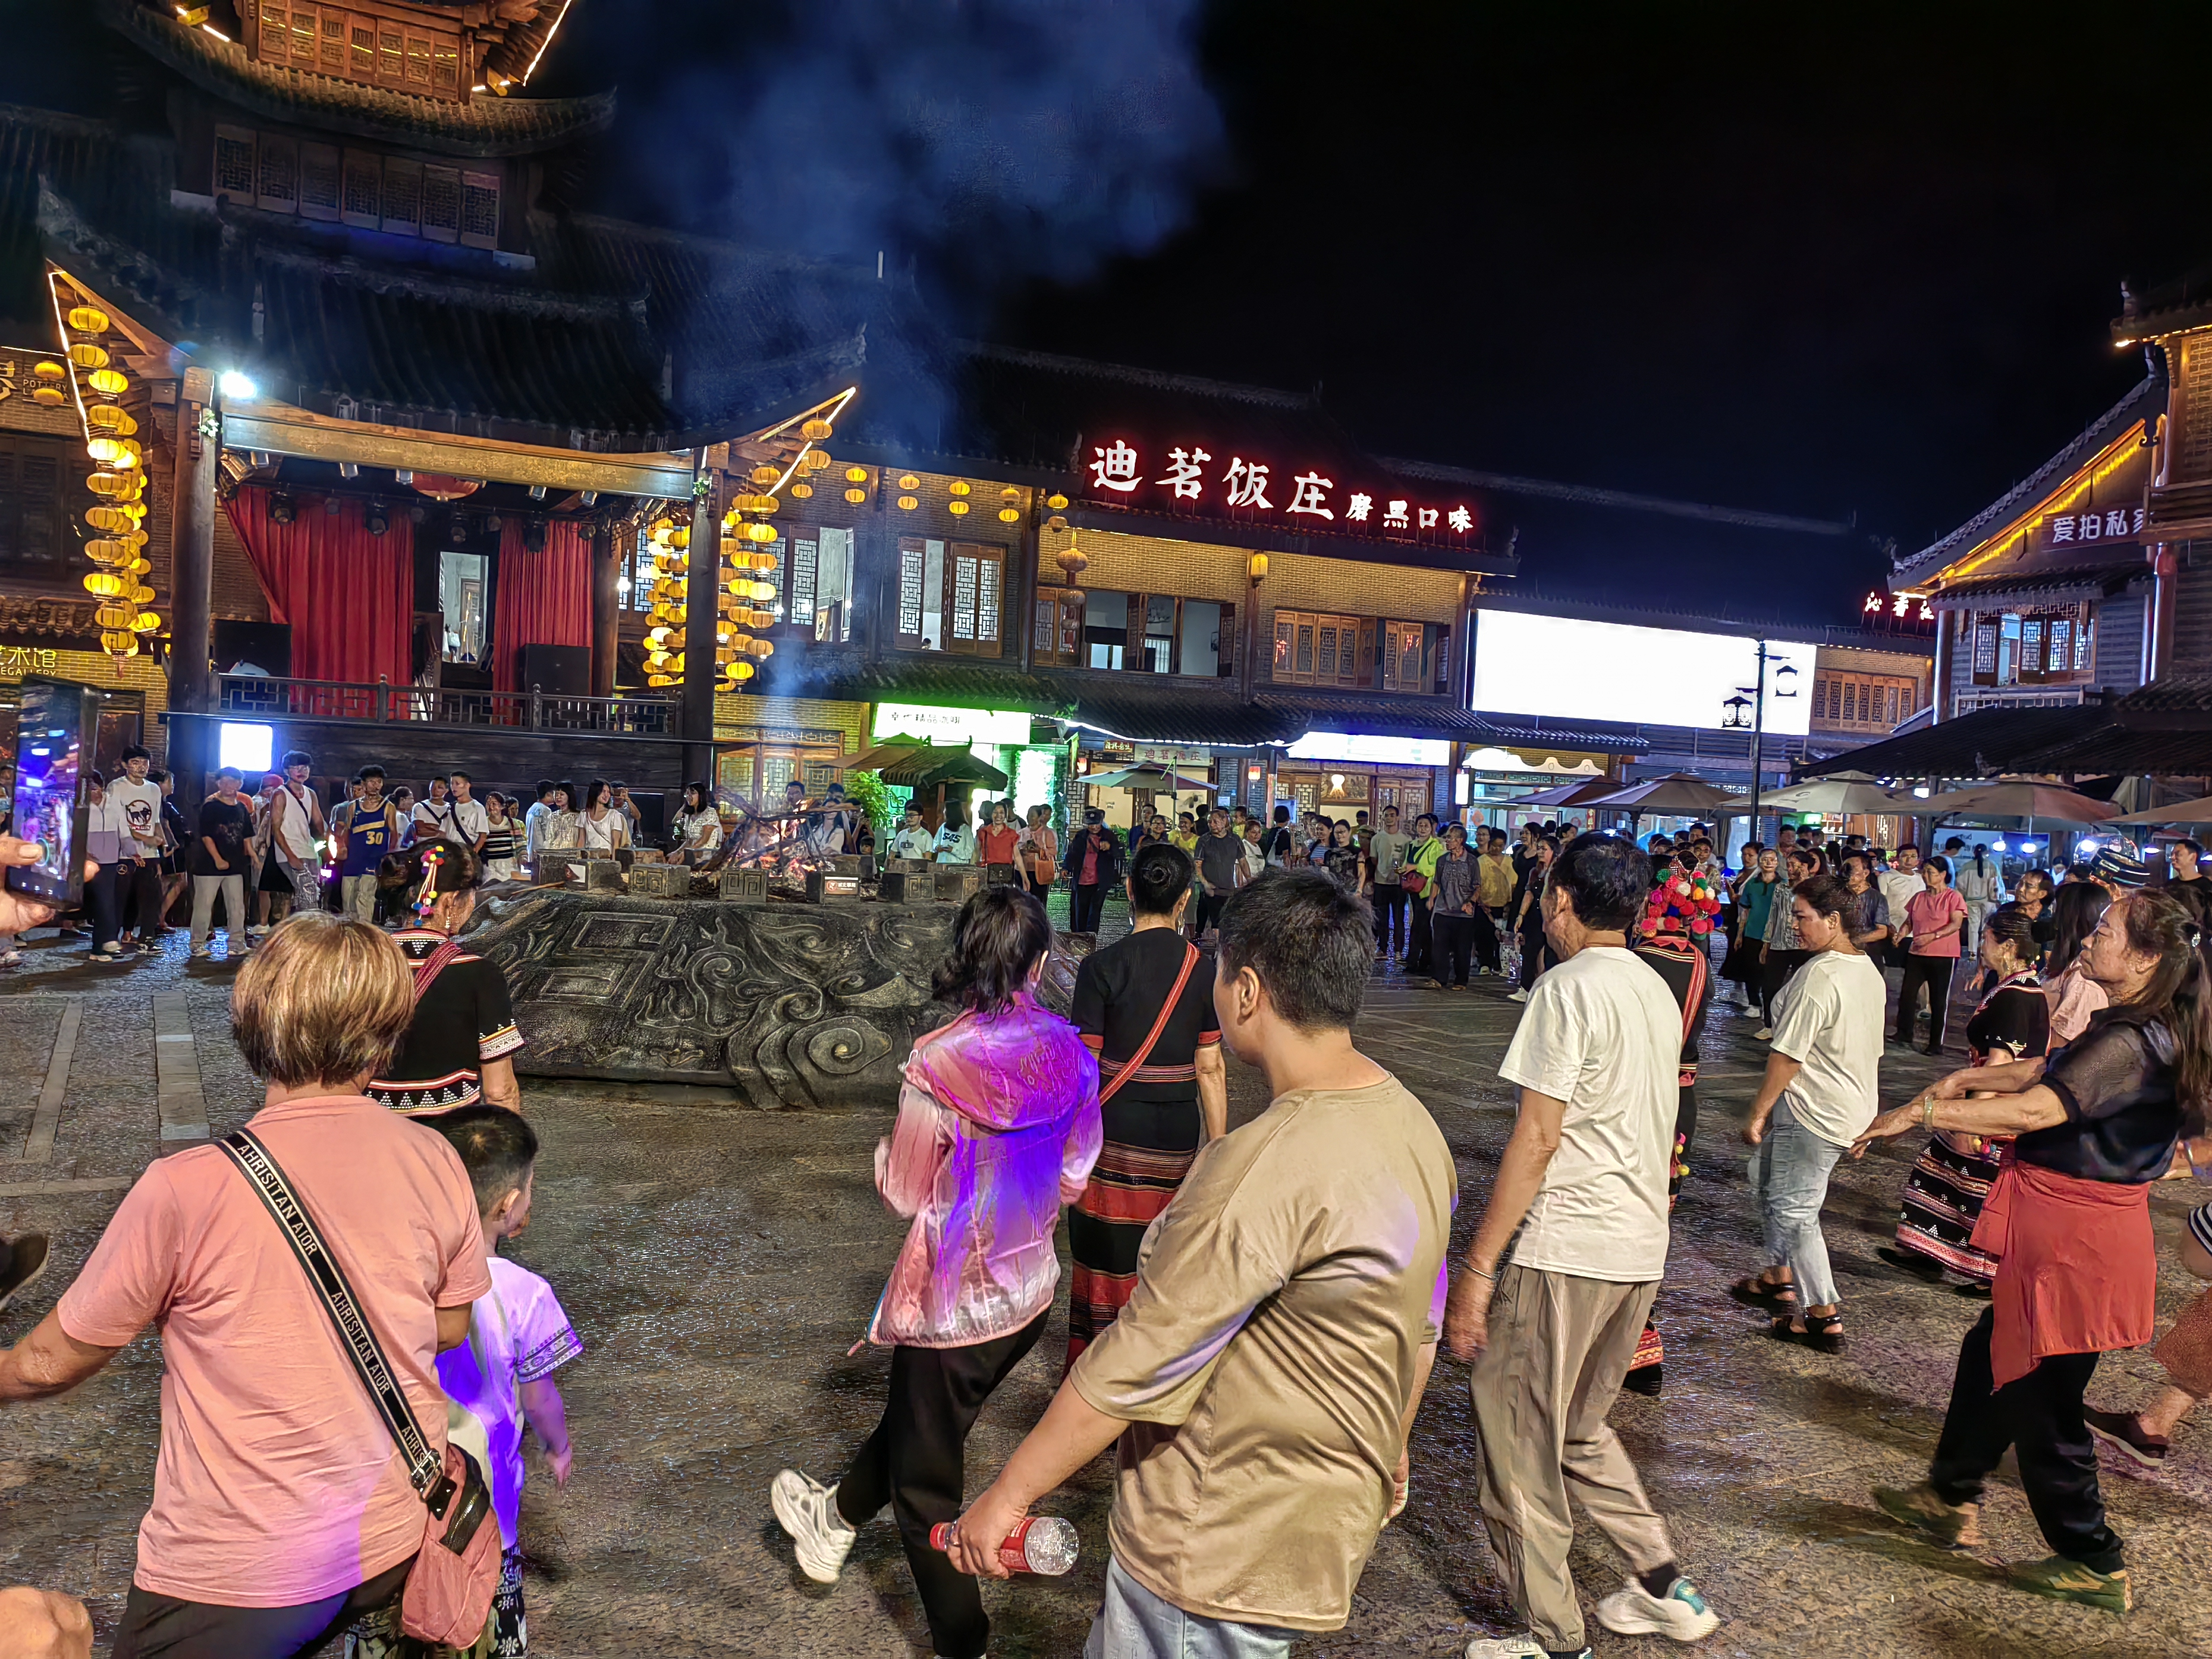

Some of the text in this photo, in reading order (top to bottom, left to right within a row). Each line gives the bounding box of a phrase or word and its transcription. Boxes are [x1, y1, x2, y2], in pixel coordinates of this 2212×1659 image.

[1090, 440, 1334, 520] 迪茗饭庄
[366, 831, 383, 845] 30
[237, 1144, 318, 1256] AHRISITAN AIOR
[331, 1292, 390, 1395] AHRISITAN AIOR
